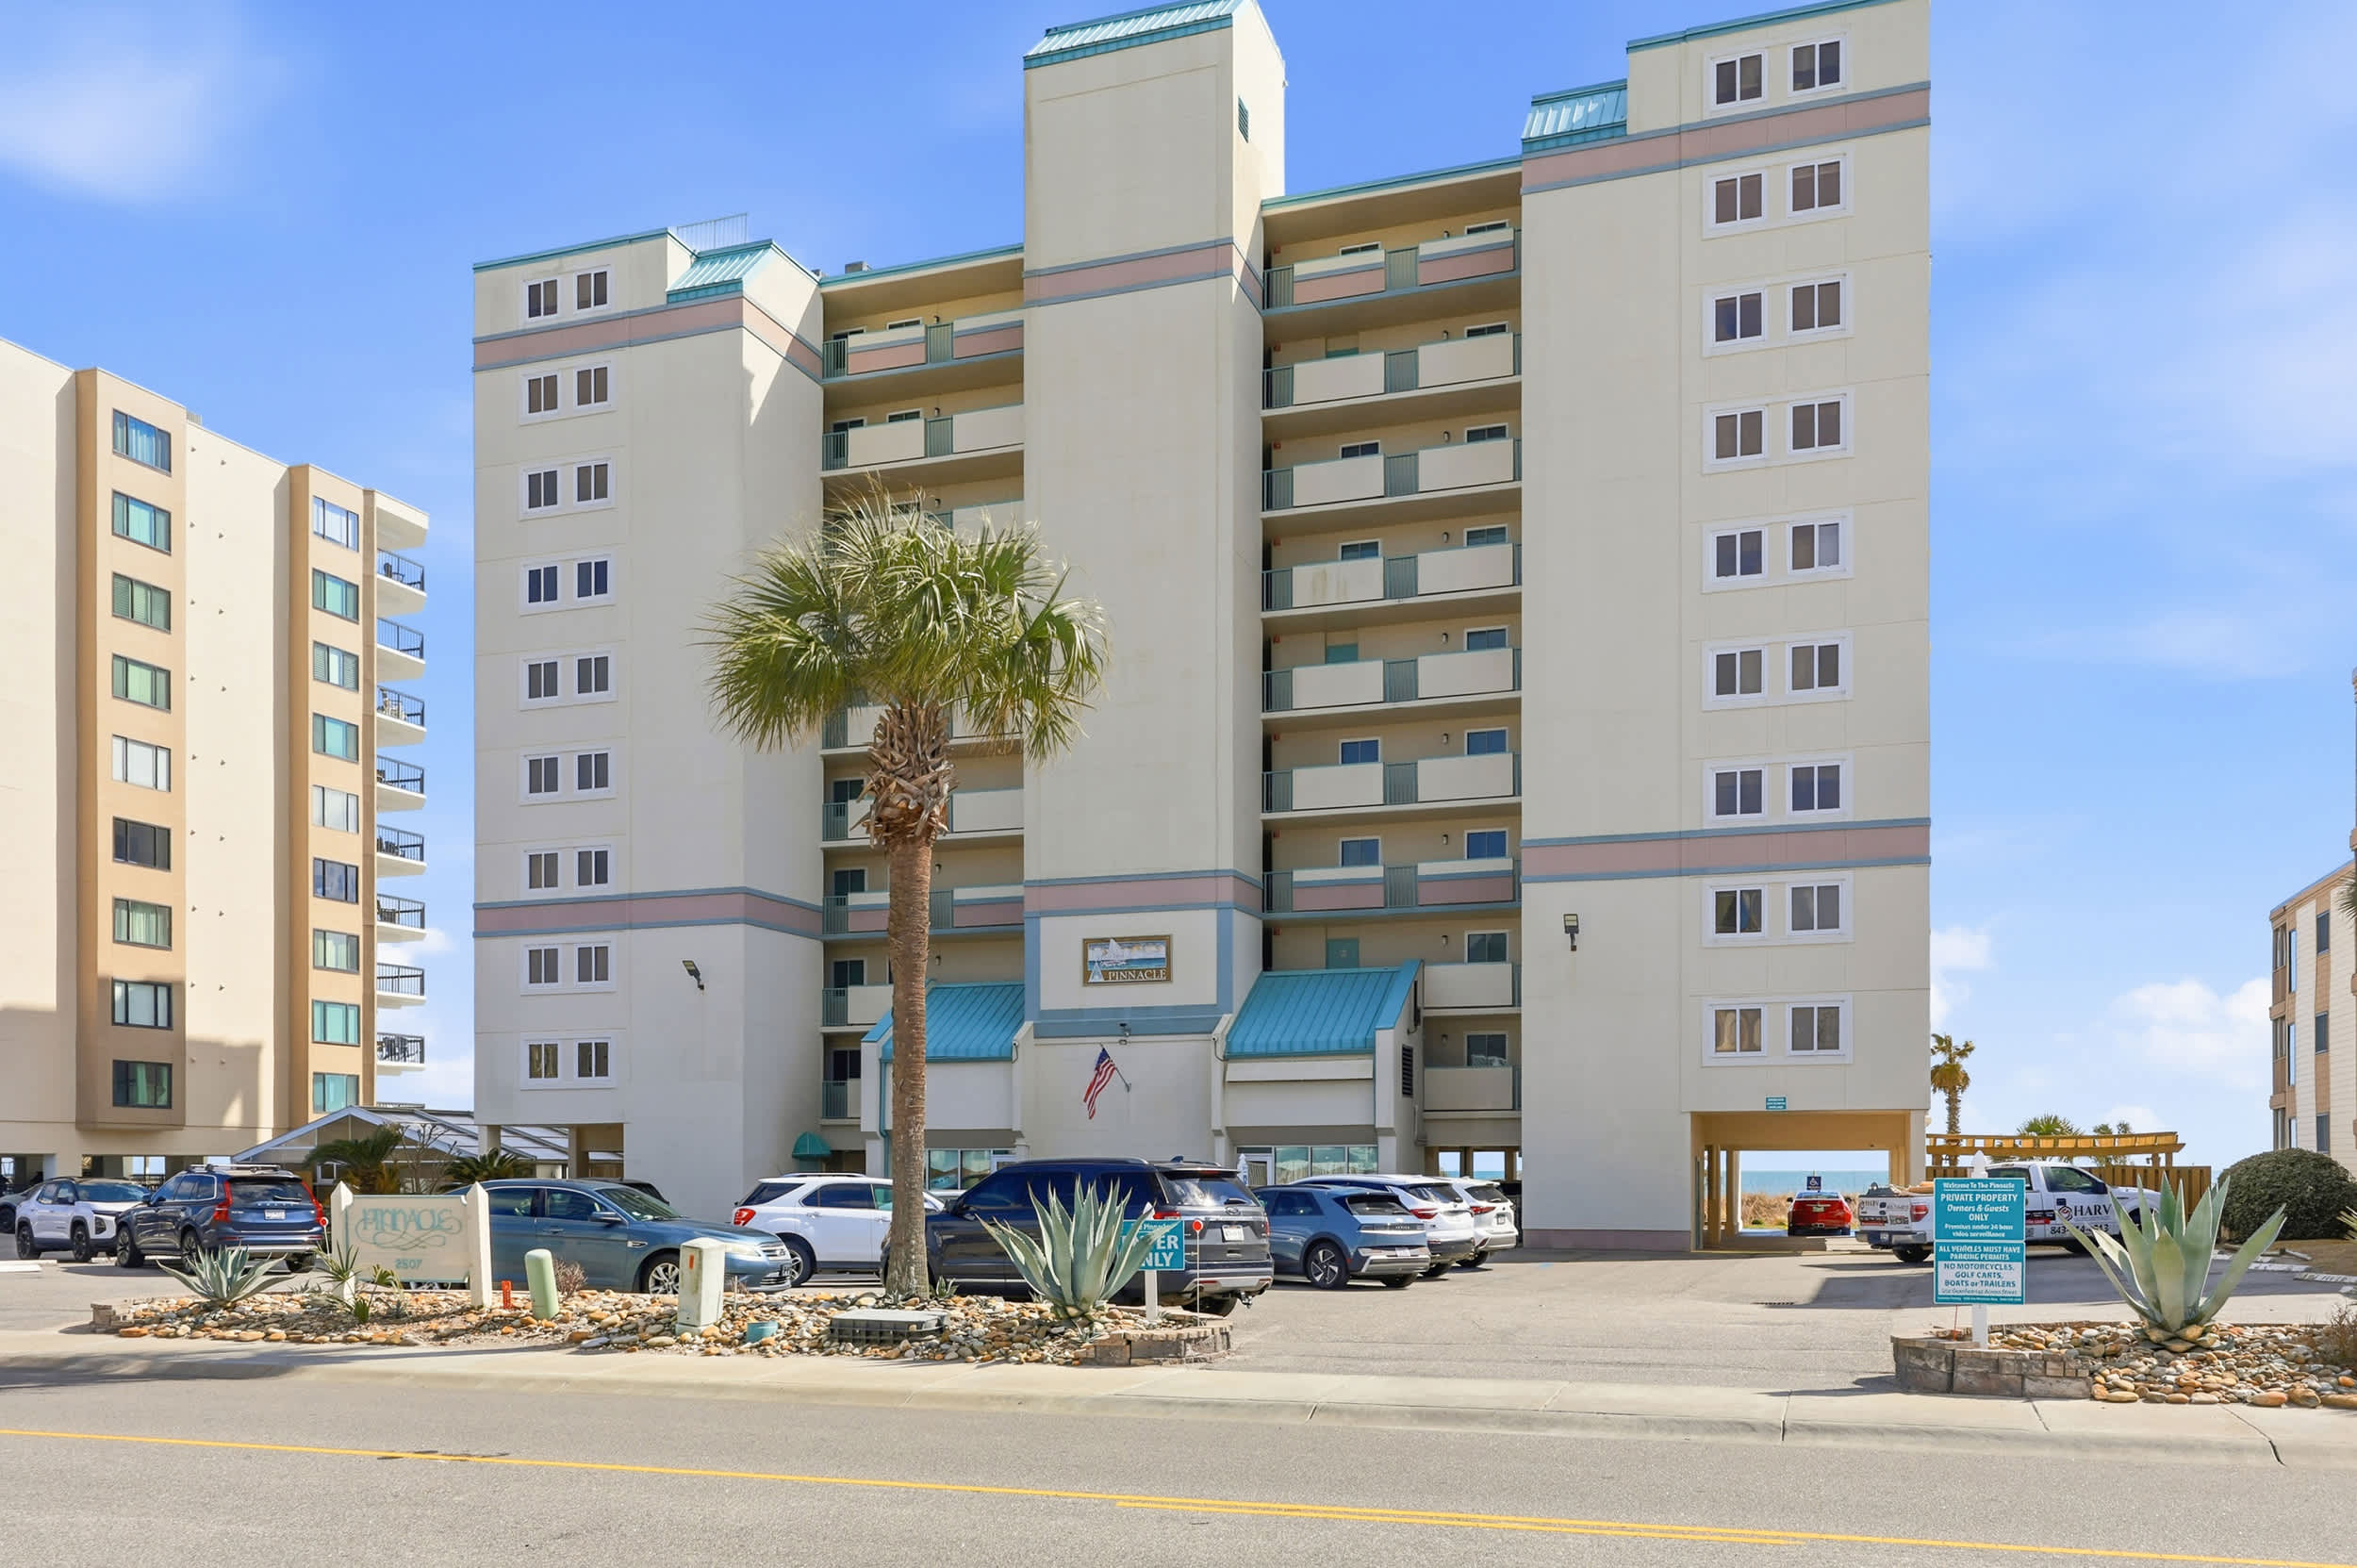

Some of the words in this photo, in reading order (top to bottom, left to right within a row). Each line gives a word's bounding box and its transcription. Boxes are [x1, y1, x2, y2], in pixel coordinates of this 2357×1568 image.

[1109, 969, 1166, 981] PINNACLE
[1940, 1194, 1973, 1202] PRIVATE
[1975, 1194, 2018, 1202] PROPERTY
[1947, 1204, 1975, 1213] Owners
[1984, 1204, 2009, 1213] Guests
[1142, 1252, 1174, 1266] NLY
